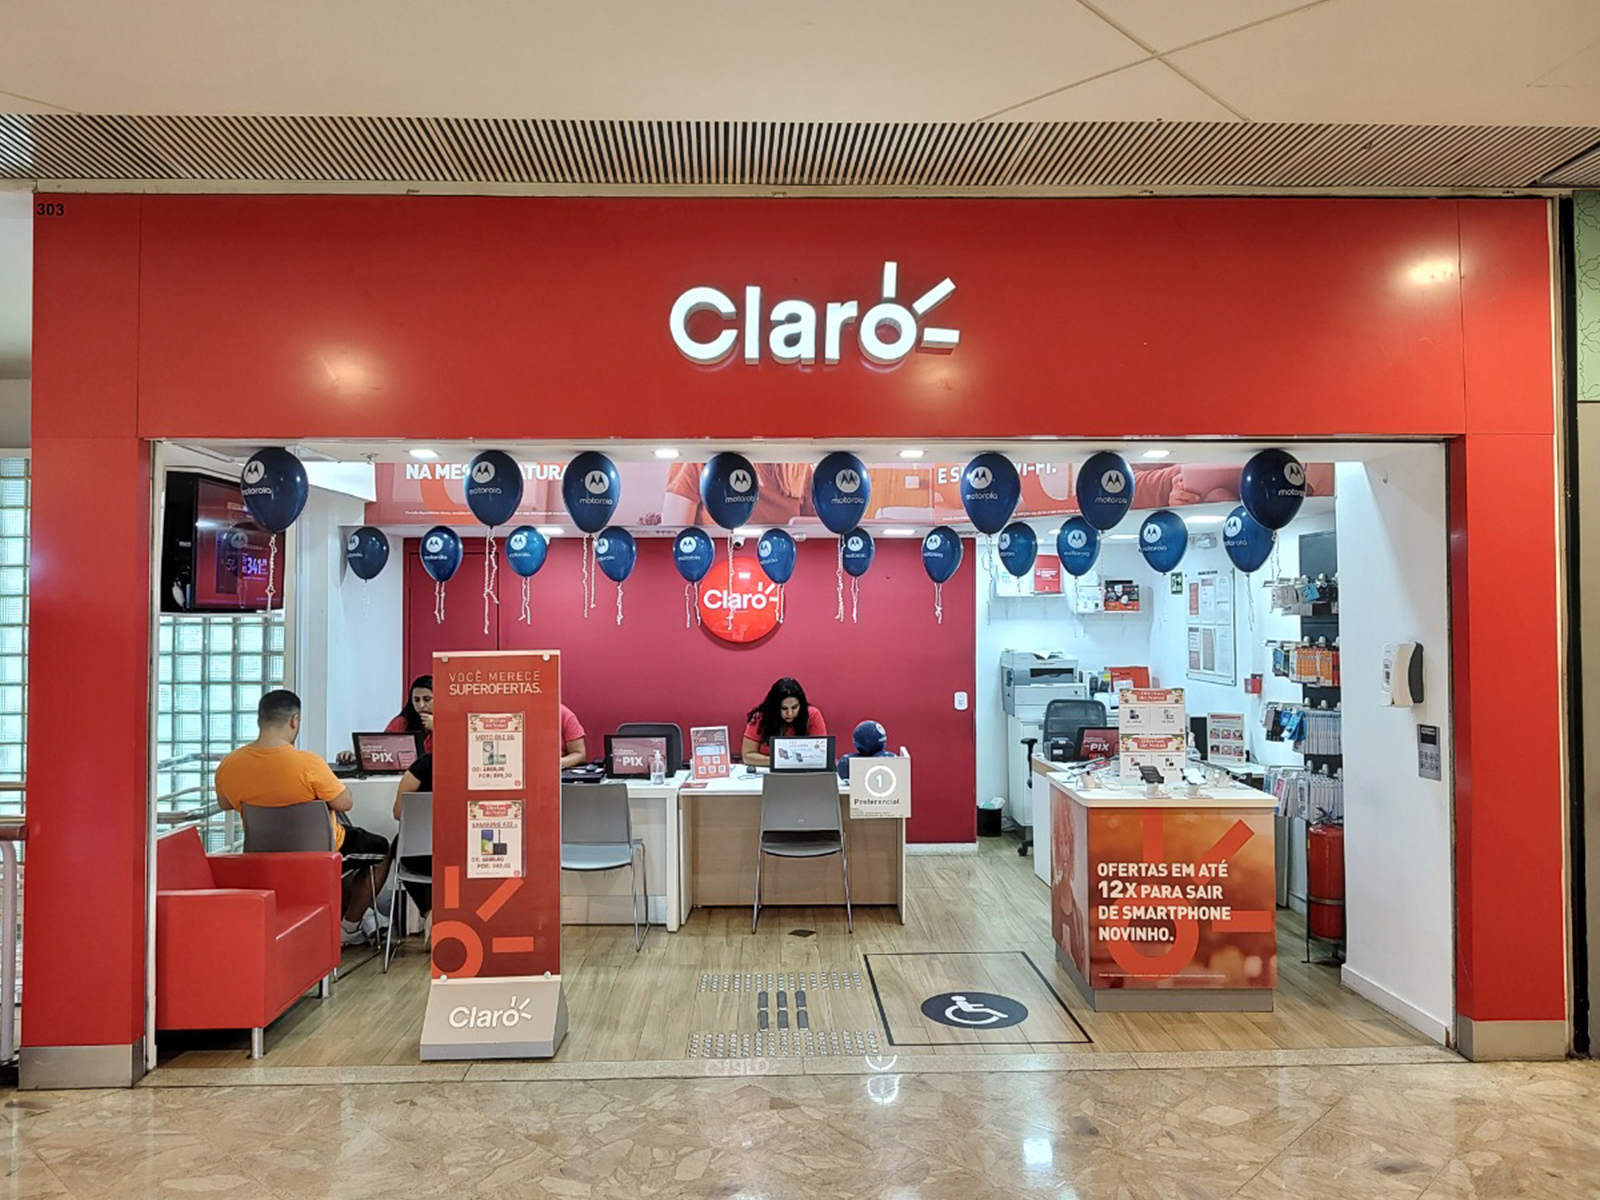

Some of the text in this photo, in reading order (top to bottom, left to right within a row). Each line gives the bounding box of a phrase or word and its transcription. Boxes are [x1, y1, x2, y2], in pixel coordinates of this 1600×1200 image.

[36, 203, 65, 216] 303
[669, 283, 919, 364] Claro
[405, 463, 432, 480] NA
[435, 463, 470, 480] MES
[469, 487, 502, 495] motorola
[965, 492, 998, 500] motorola
[579, 497, 613, 505] motorola
[1094, 496, 1127, 504] motorola
[703, 587, 769, 610] Claro
[448, 670, 541, 682] VOCÊ MERECE
[449, 682, 543, 696] SUPEROFERTAS.
[1090, 743, 1110, 751] PIX
[371, 753, 394, 763] PIX
[622, 756, 644, 767] PIX
[876, 774, 882, 788] 1
[1097, 859, 1228, 877] OFERTAS EM ATÉ
[1097, 880, 1223, 899] 12X PARA SAIR
[1098, 905, 1232, 920] DE SMARTPHONE
[1098, 927, 1175, 941] NOVINHO.
[448, 1004, 521, 1028] Claro
